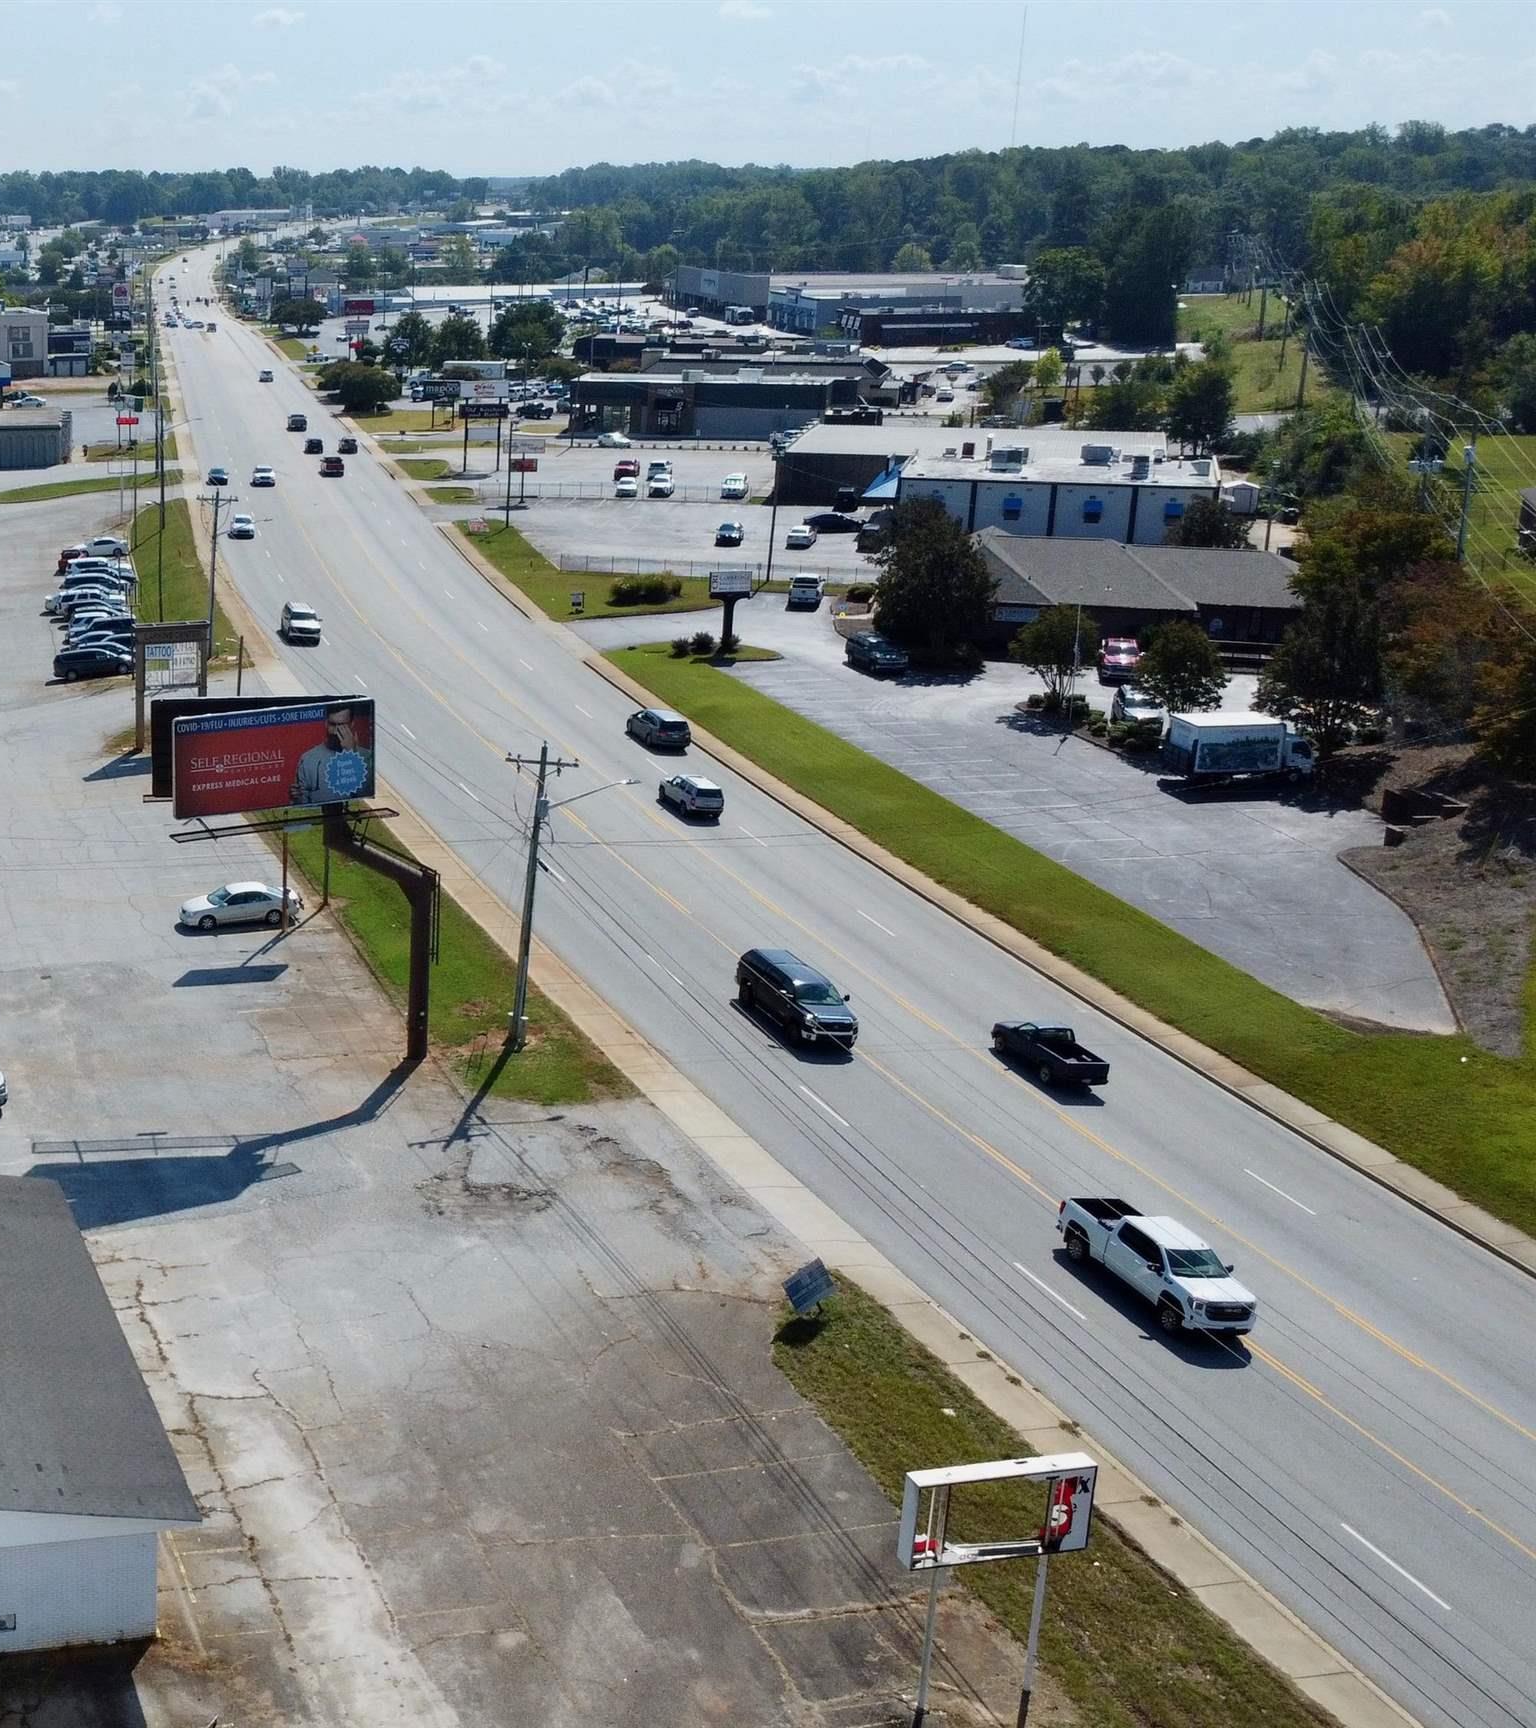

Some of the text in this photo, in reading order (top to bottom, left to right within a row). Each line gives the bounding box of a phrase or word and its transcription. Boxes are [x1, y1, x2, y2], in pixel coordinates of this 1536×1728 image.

[146, 645, 172, 658] TATTOO
[176, 708, 325, 733] COVID-19/FLU INJURIES/CUTS SORE THROAT
[190, 749, 285, 770] SELF REGIONAL
[192, 774, 281, 792] EXPRESS MEDICAL CARE
